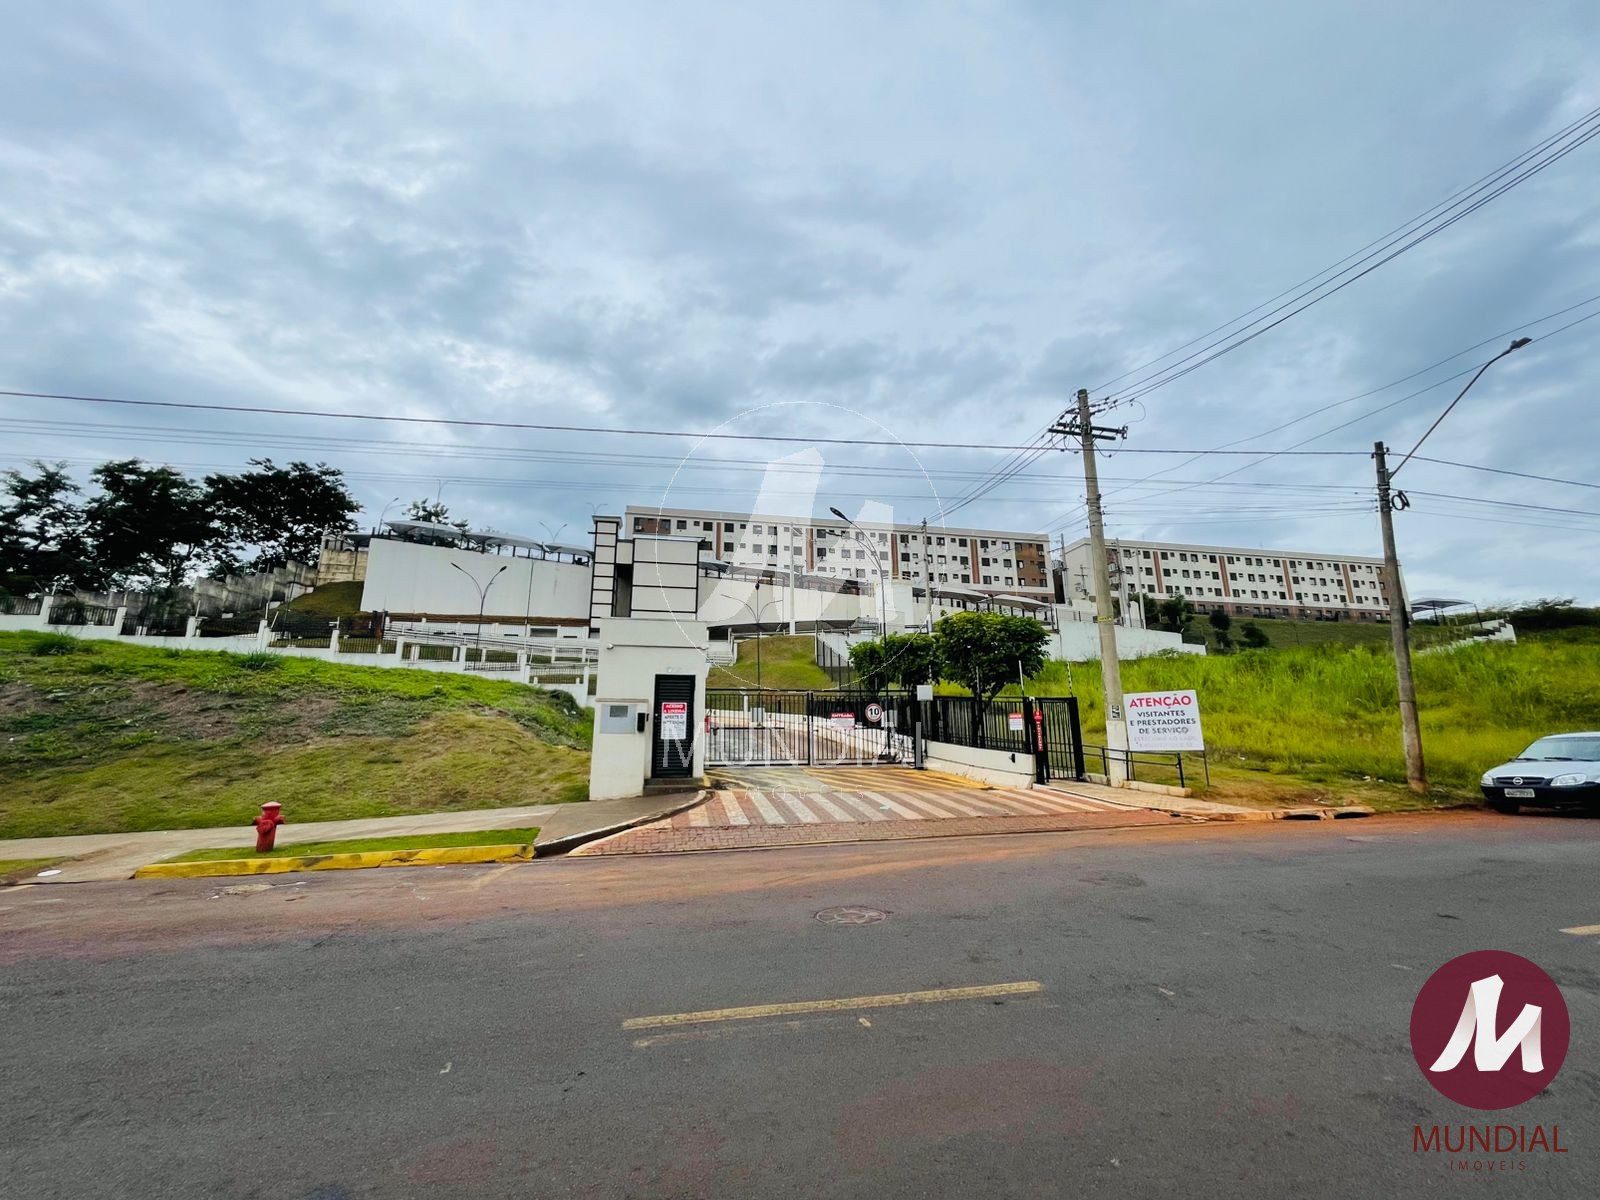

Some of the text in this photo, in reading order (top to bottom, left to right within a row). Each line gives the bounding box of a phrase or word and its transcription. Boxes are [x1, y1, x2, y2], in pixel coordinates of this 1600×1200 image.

[1129, 693, 1191, 709] ATENÇÃO
[869, 708, 879, 716] 10
[1137, 710, 1186, 718] VISITANTES
[1137, 718, 1196, 726] PRESTADORES
